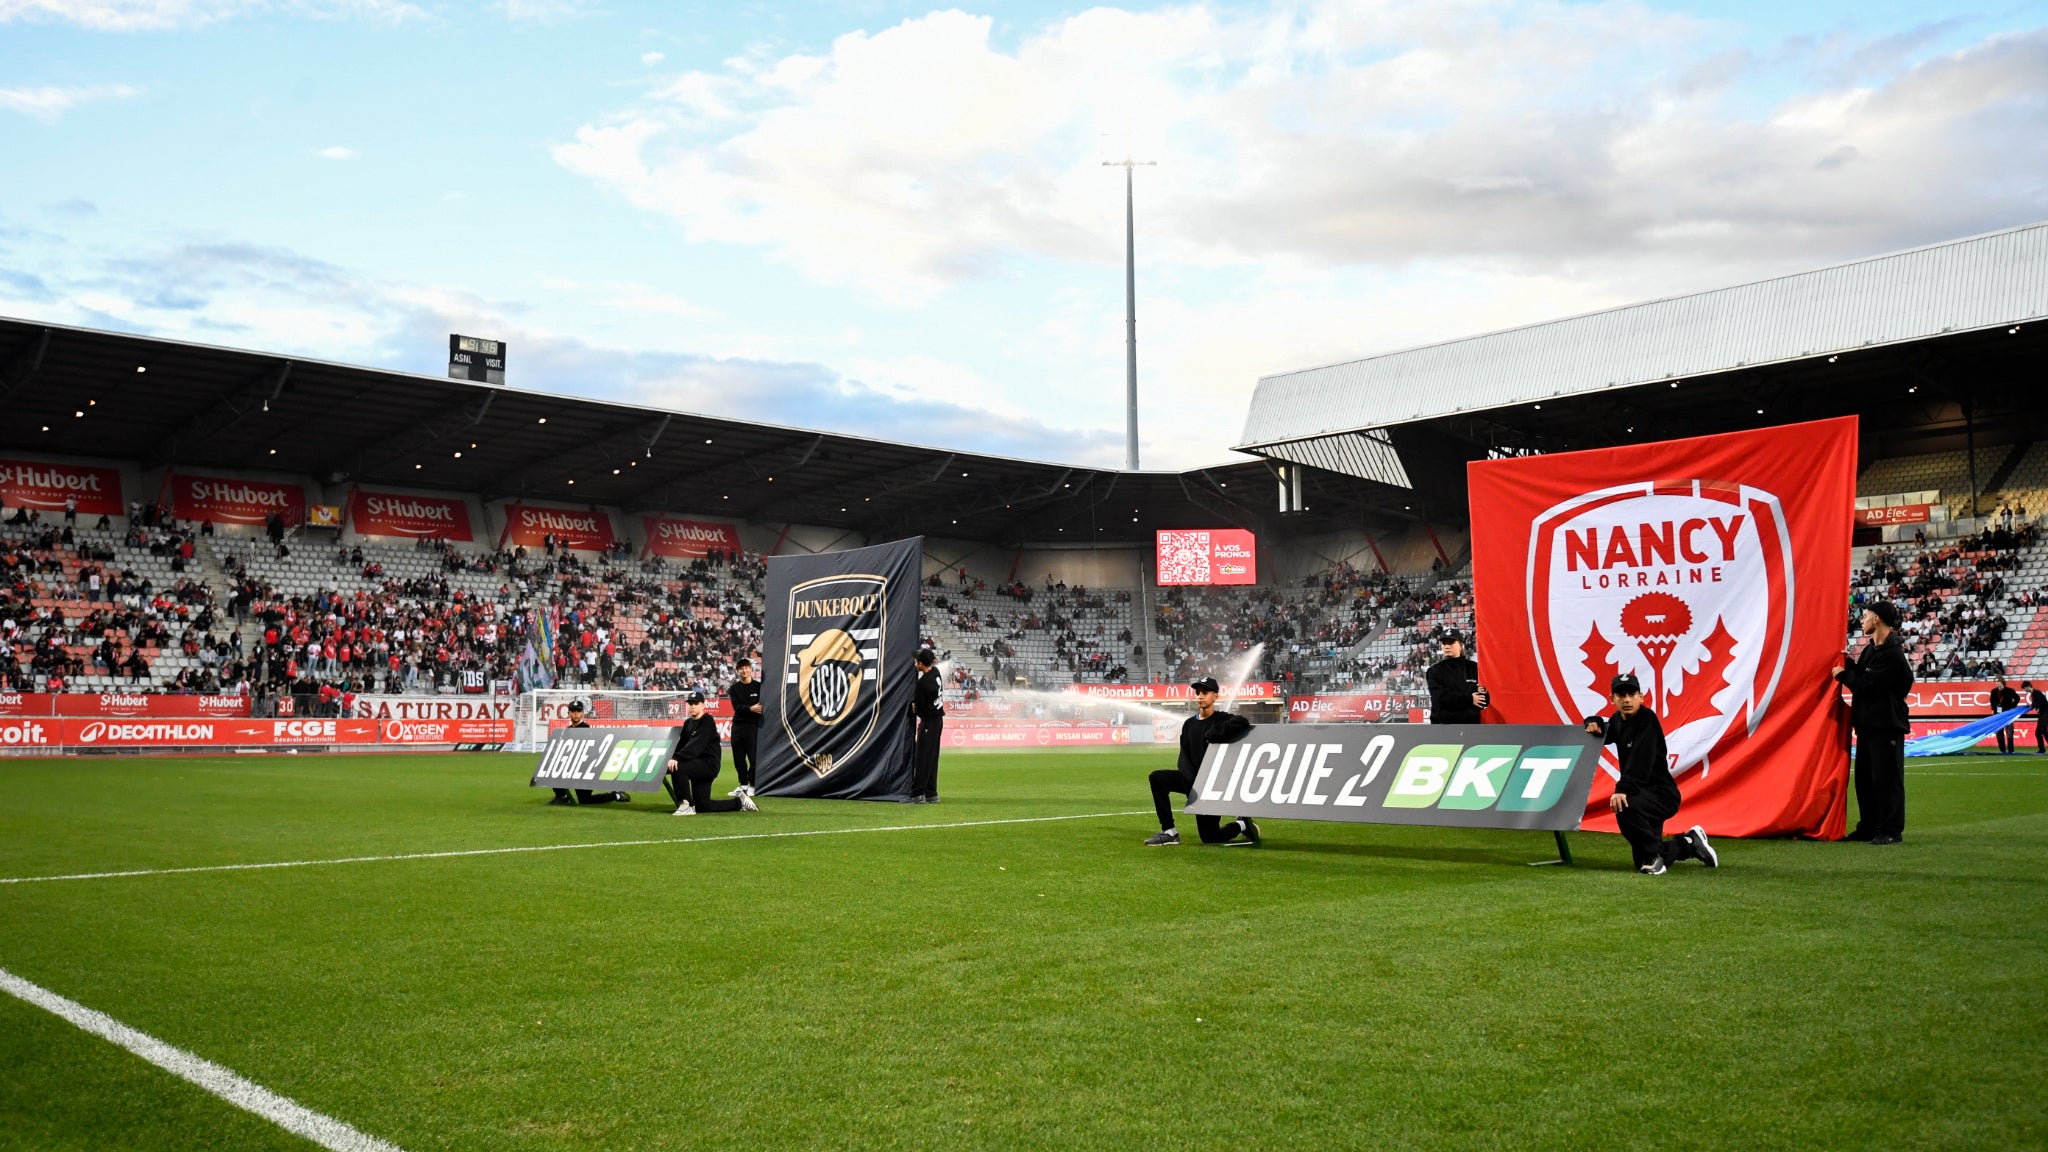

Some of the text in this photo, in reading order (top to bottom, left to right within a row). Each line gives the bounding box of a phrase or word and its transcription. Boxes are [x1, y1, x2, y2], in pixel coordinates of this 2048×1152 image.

[453, 353, 472, 364] ASNL
[485, 358, 503, 369] VISIT.
[16, 466, 102, 491] Hubert
[192, 481, 289, 506] St Hubert
[367, 497, 453, 521] St Hubert
[1866, 510, 1884, 520] AD
[1886, 507, 1908, 518] Élec
[521, 510, 599, 532] St Hubert
[673, 523, 728, 543] Hubert
[1214, 543, 1240, 552] À VOS
[1565, 514, 1745, 572] NANCY
[1582, 566, 1722, 590] LORRAINE
[795, 594, 879, 619] DUNKERQUE
[811, 663, 849, 718] USLD
[1088, 686, 1154, 697] McDonald's
[1218, 685, 1264, 697] Donald's
[1272, 685, 1281, 694] 25
[111, 695, 148, 706] Hubert
[209, 696, 244, 708] Hubert
[279, 700, 294, 713] 30
[1292, 698, 1334, 711] AD Élec
[1364, 699, 1383, 711] AD
[1406, 699, 1416, 709] 24
[358, 702, 511, 719] SATURDAY
[668, 704, 680, 714] 29
[0, 721, 47, 743] oit.
[108, 724, 213, 741] DECATHLON
[274, 721, 336, 737] FCGE
[386, 720, 445, 740] OXYGEN
[1056, 732, 1104, 740] NISSAN NANCY
[537, 733, 668, 780] LIGUE 2 BKT
[1200, 735, 1572, 807] LIGUE 2 BKT
